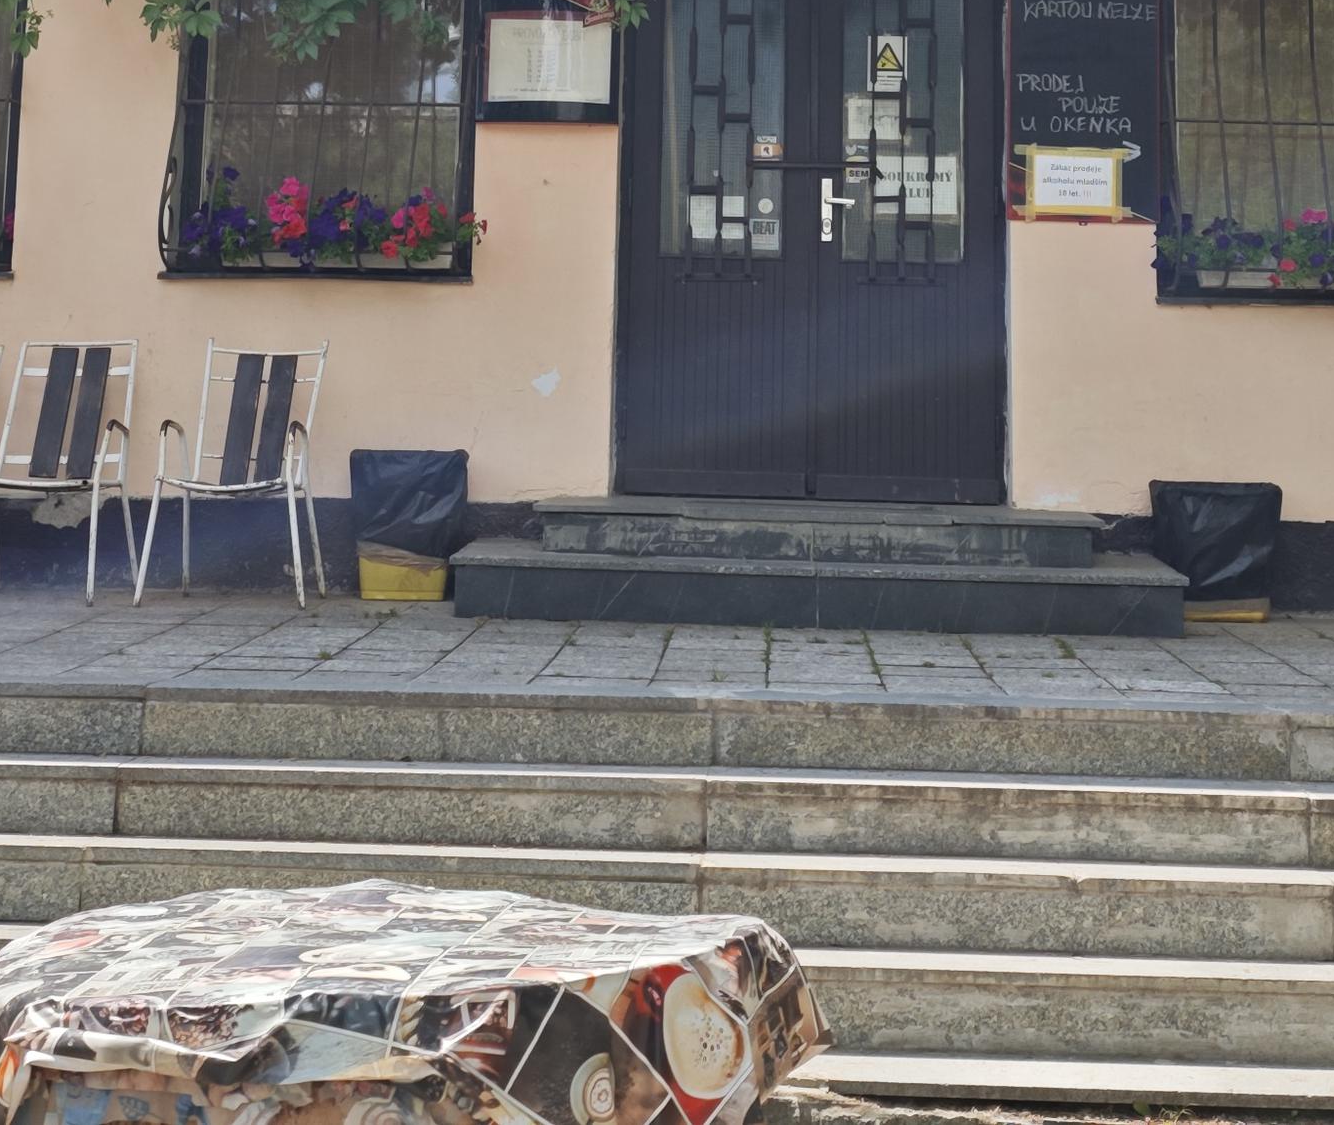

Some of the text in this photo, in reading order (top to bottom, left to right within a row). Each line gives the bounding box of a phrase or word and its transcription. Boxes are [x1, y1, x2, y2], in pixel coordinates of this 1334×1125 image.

[1024, 0, 1157, 22] KARTOU NELZE
[1017, 73, 1084, 94] PRODEJ
[1058, 95, 1121, 114] POUZE
[1020, 116, 1132, 135] U OKENKA
[1073, 164, 1102, 174] prodeje
